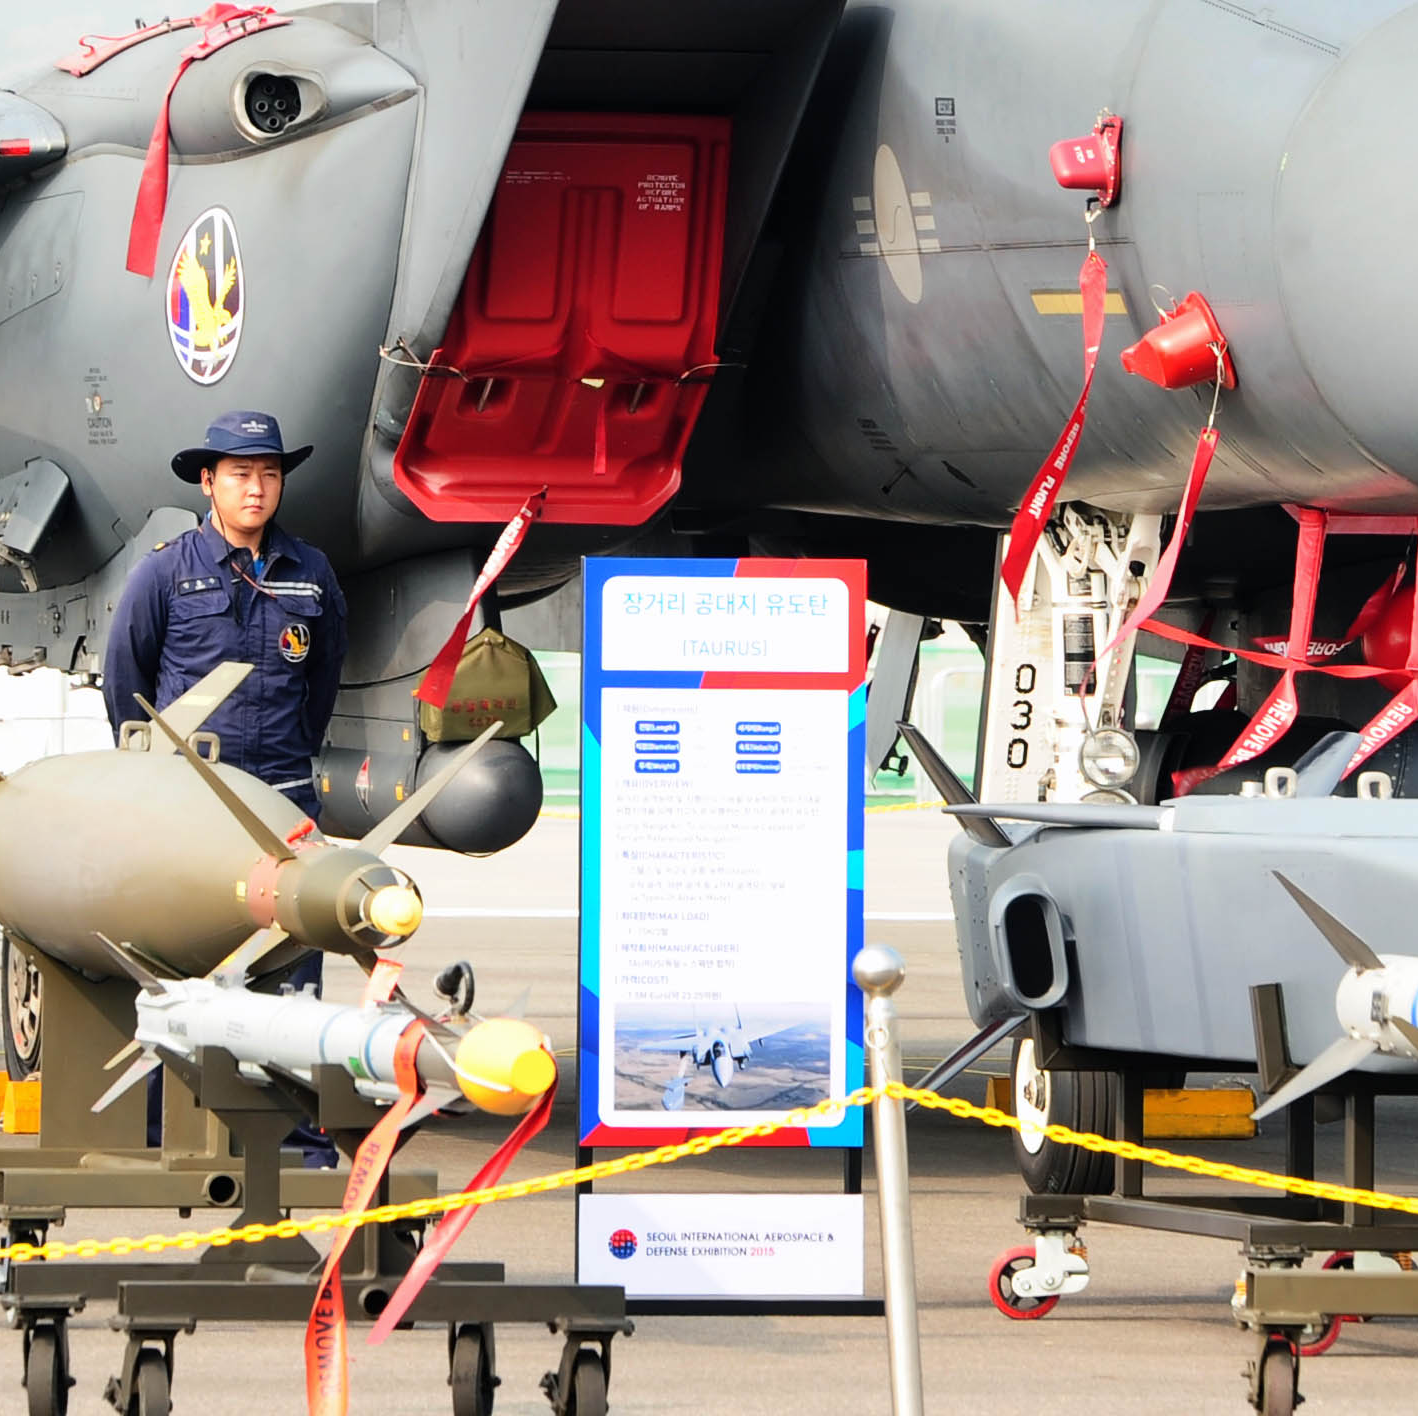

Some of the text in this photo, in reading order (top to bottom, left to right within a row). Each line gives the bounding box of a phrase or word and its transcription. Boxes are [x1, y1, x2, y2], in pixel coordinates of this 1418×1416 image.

[1028, 424, 1080, 520] BEFORE FLIGHT
[622, 592, 829, 617] 장거리 공대지 유도탄
[1007, 664, 1036, 768] 030
[1248, 698, 1294, 756] REMOVE
[1363, 701, 1414, 752] REMOVE
[646, 1232, 834, 1242] SEOUL INTERNATIONAL AEROSPACE &
[646, 1247, 775, 1257] DEFENSE EXHIBITION 2015
